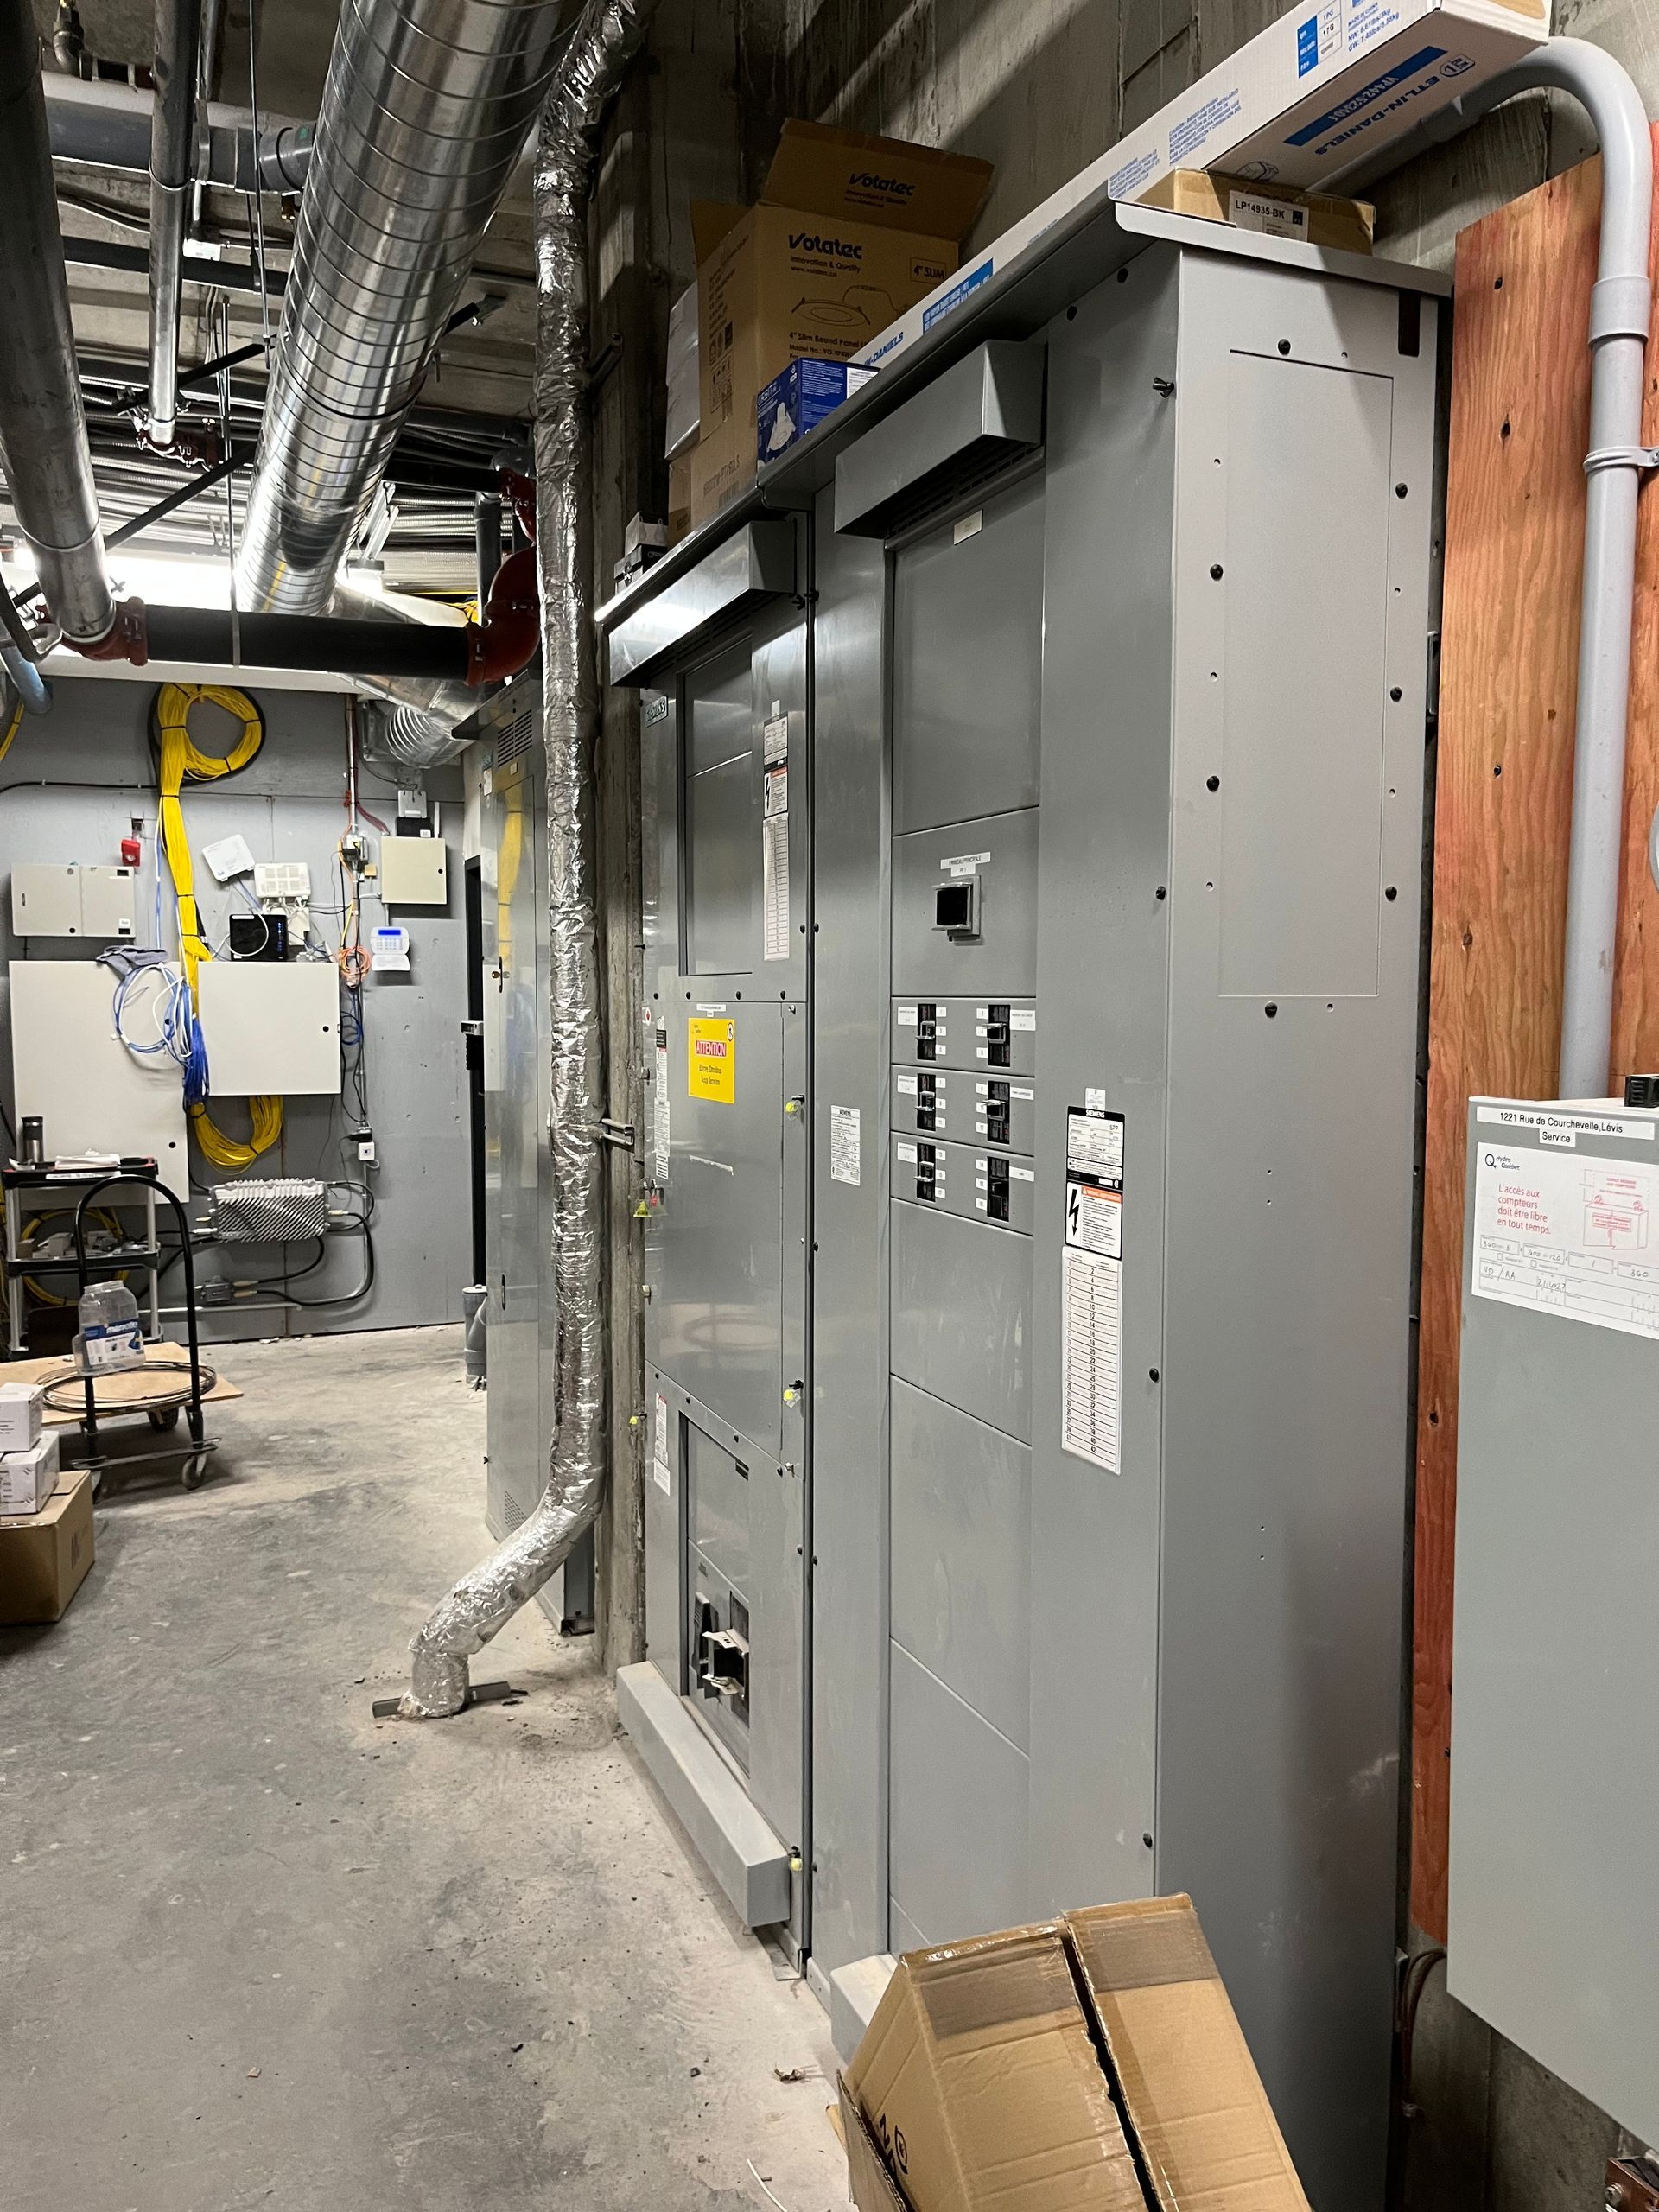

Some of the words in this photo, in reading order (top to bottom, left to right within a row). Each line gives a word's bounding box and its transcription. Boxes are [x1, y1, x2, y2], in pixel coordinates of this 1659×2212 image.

[1314, 75, 1440, 156] ETLIN-DANIELS
[849, 173, 915, 196] Votatec
[1236, 200, 1285, 219] LP14935-BK
[788, 232, 863, 260] Votatec
[790, 256, 828, 268] Innovation
[836, 262, 861, 274] Quality
[798, 332, 813, 341] Slim
[815, 334, 838, 345] Round
[839, 339, 860, 347] Panel
[789, 344, 809, 353] Model
[696, 1040, 726, 1057] ATTENTION
[1085, 1109, 1105, 1118] SIEMENS
[1500, 1112, 1516, 1122] 1221
[1519, 1114, 1534, 1124] Rue
[1536, 1116, 1546, 1126] de
[1542, 1132, 1571, 1143] Service
[1499, 1183, 1525, 1196] L'accès
[1526, 1190, 1540, 1198] aux
[1498, 1196, 1538, 1210] compteurs
[1498, 1206, 1512, 1217] doit
[1514, 1208, 1529, 1219] être
[1530, 1211, 1548, 1223] libre
[1508, 1219, 1523, 1230] tout
[1525, 1223, 1551, 1235] temps.
